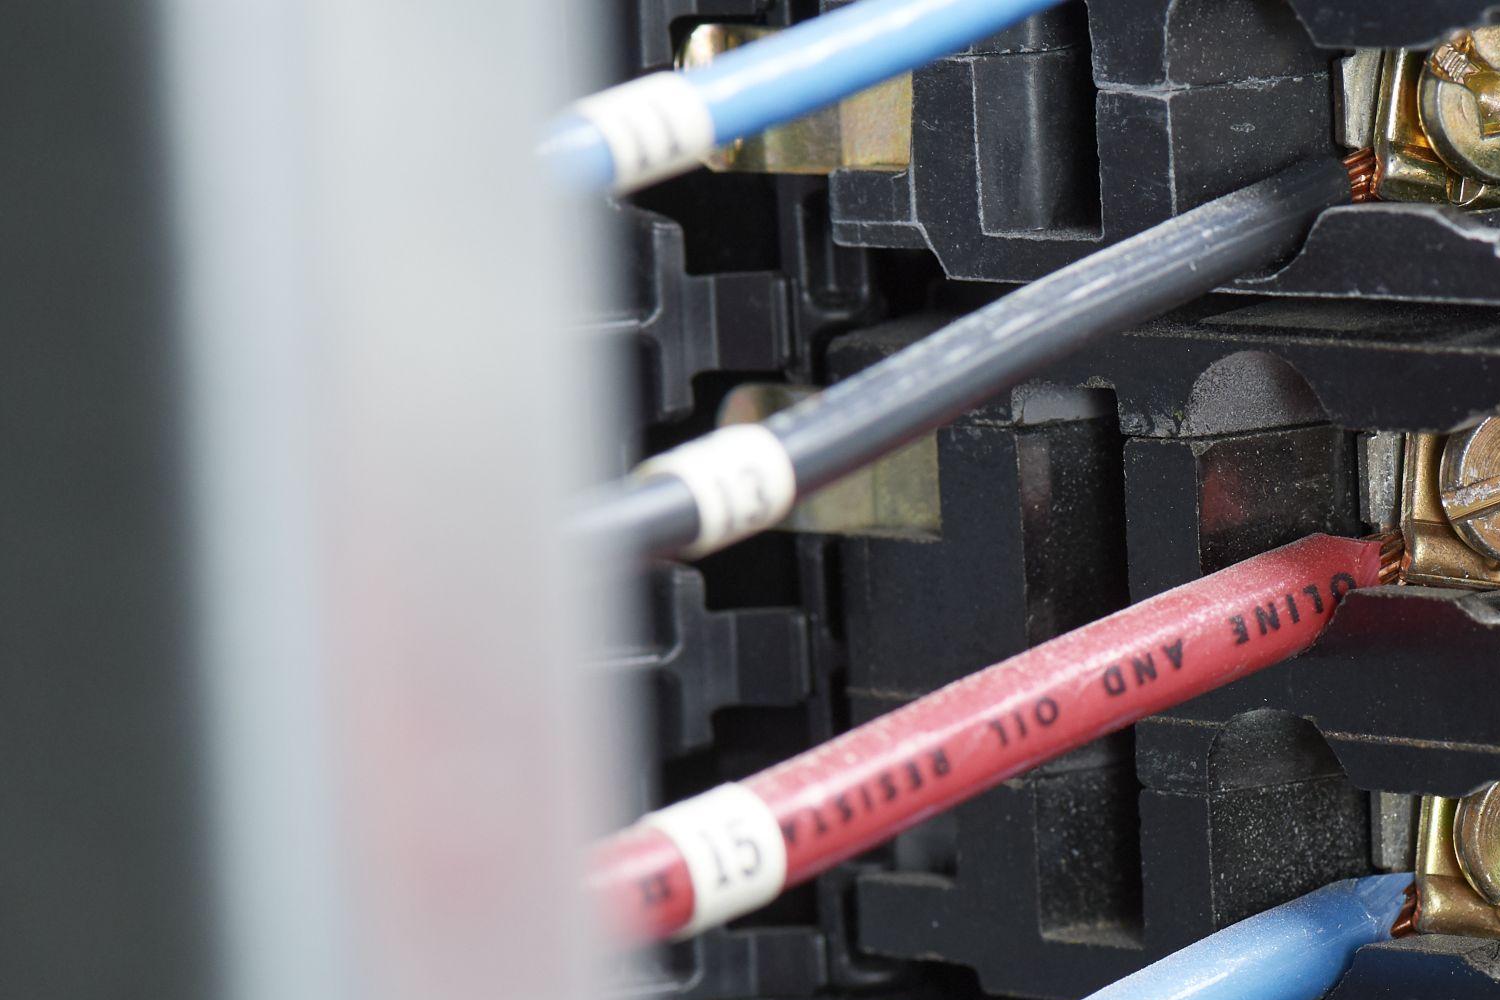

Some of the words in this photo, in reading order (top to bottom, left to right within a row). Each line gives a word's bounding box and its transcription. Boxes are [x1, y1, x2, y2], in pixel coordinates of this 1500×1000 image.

[1103, 639, 1184, 695] AND
[989, 697, 1057, 747] OIL
[706, 827, 764, 888] 15
